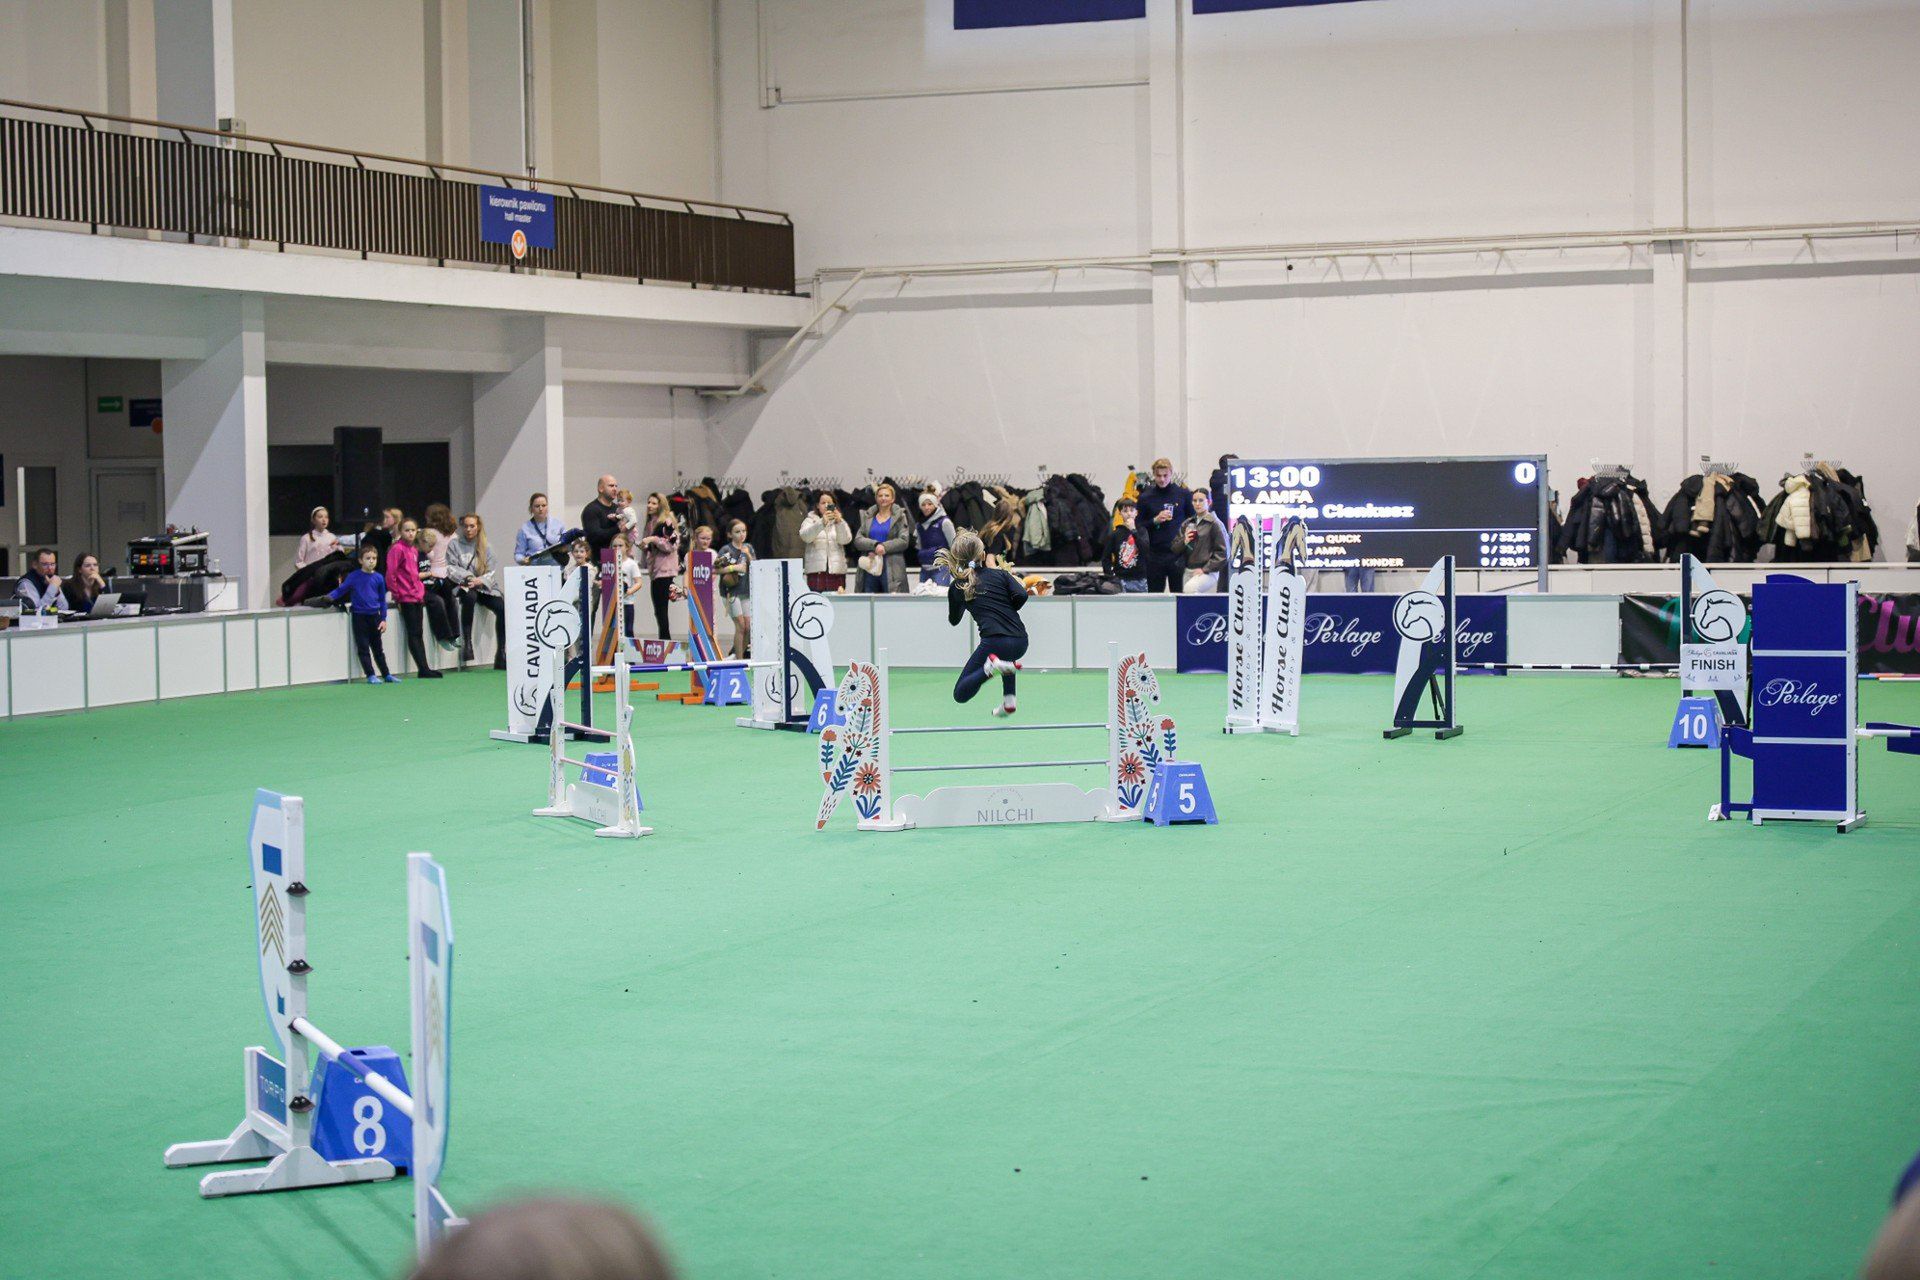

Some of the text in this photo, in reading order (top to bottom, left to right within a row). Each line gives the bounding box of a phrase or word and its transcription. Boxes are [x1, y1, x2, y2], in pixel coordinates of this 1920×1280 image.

[489, 195, 546, 213] kierownik pawilonu
[504, 211, 532, 223] hall master
[1230, 466, 1320, 488] 13:00
[1515, 463, 1536, 484] 0
[1255, 490, 1314, 504] AMFA
[1326, 534, 1361, 543] QUICK
[1314, 546, 1347, 555] AMFA
[1361, 557, 1404, 567] KINDER
[693, 566, 711, 584] mtp
[1304, 613, 1381, 657] Perlage
[1432, 617, 1494, 658] elage
[645, 642, 662, 657] mtp
[1232, 584, 1244, 710] Horse Club
[1271, 586, 1291, 714] Horse Club
[1691, 659, 1736, 670] FINISH
[709, 678, 717, 698] 2
[729, 678, 742, 698] 2
[1758, 678, 1838, 716] Perlage
[817, 703, 828, 726] 6
[1679, 714, 1708, 739] 10
[1149, 782, 1160, 812] 5
[1179, 783, 1196, 814] 5
[977, 808, 1034, 822] NILCHI
[353, 1095, 387, 1156] 8
